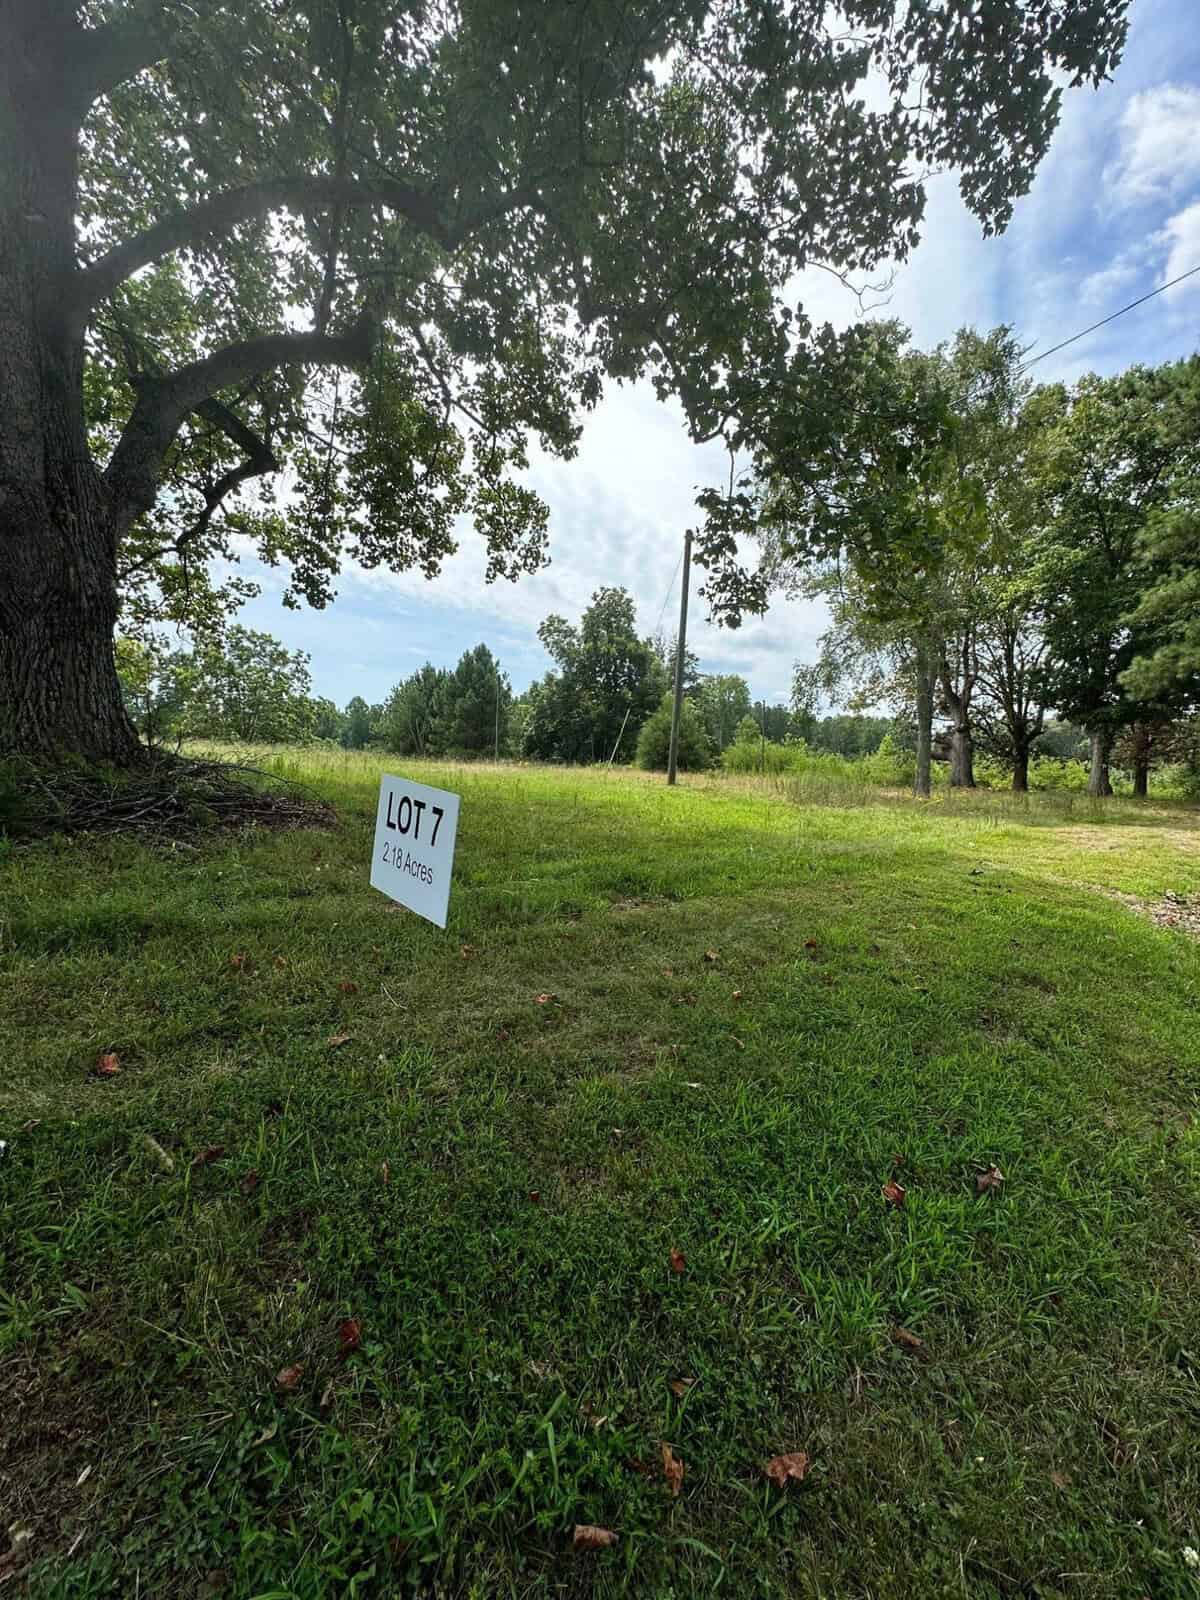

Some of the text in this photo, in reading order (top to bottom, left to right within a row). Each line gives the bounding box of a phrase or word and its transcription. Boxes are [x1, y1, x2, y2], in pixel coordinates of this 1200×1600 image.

[386, 791, 444, 847] LOT 7
[382, 841, 433, 885] 2.18 Acres
